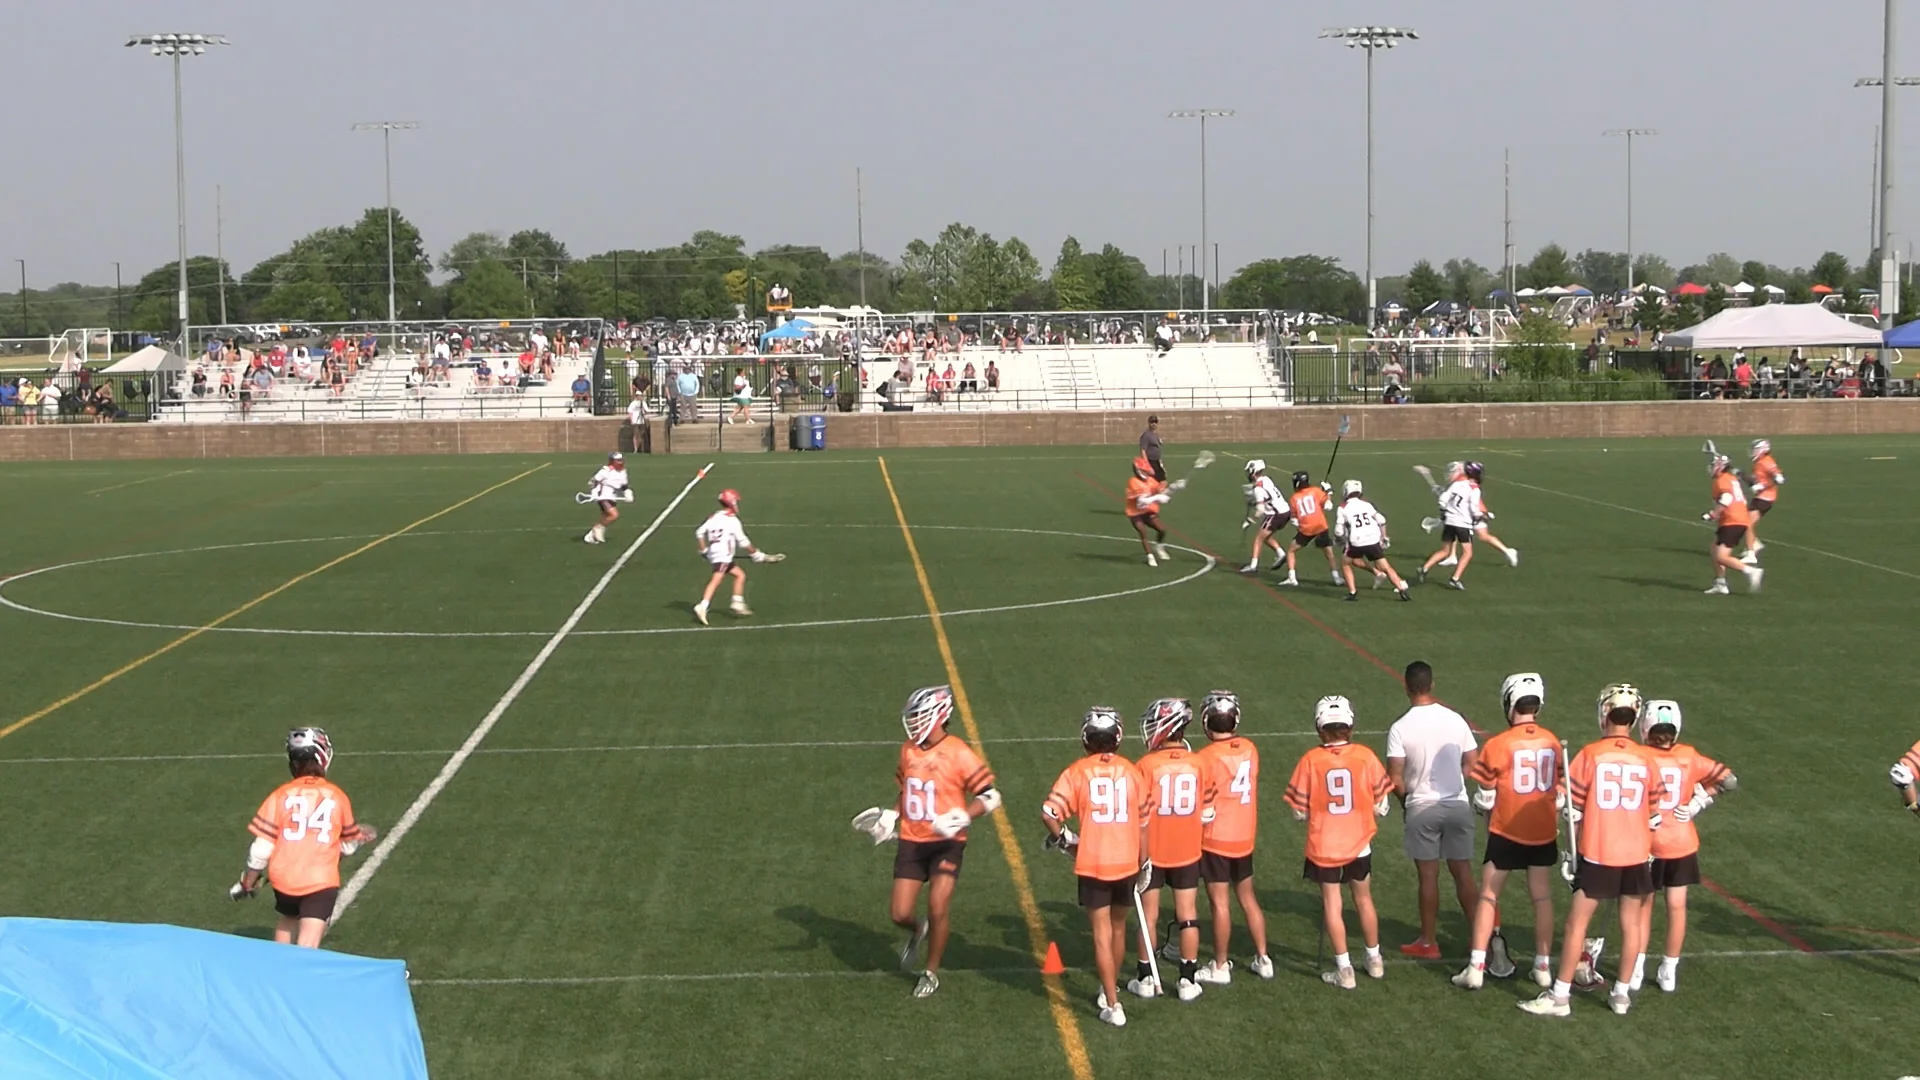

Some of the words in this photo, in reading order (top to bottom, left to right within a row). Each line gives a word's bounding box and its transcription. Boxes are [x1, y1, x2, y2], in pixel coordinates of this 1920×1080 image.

[1296, 495, 1316, 517] 10
[1353, 512, 1371, 529] 35
[1230, 760, 1252, 805] 4
[1325, 768, 1354, 815] 9
[1513, 748, 1556, 794] 60
[1595, 762, 1648, 811] 65
[905, 777, 938, 822] 61
[1089, 776, 1129, 824] 91
[1157, 773, 1197, 816] 18
[283, 795, 336, 844] 34
